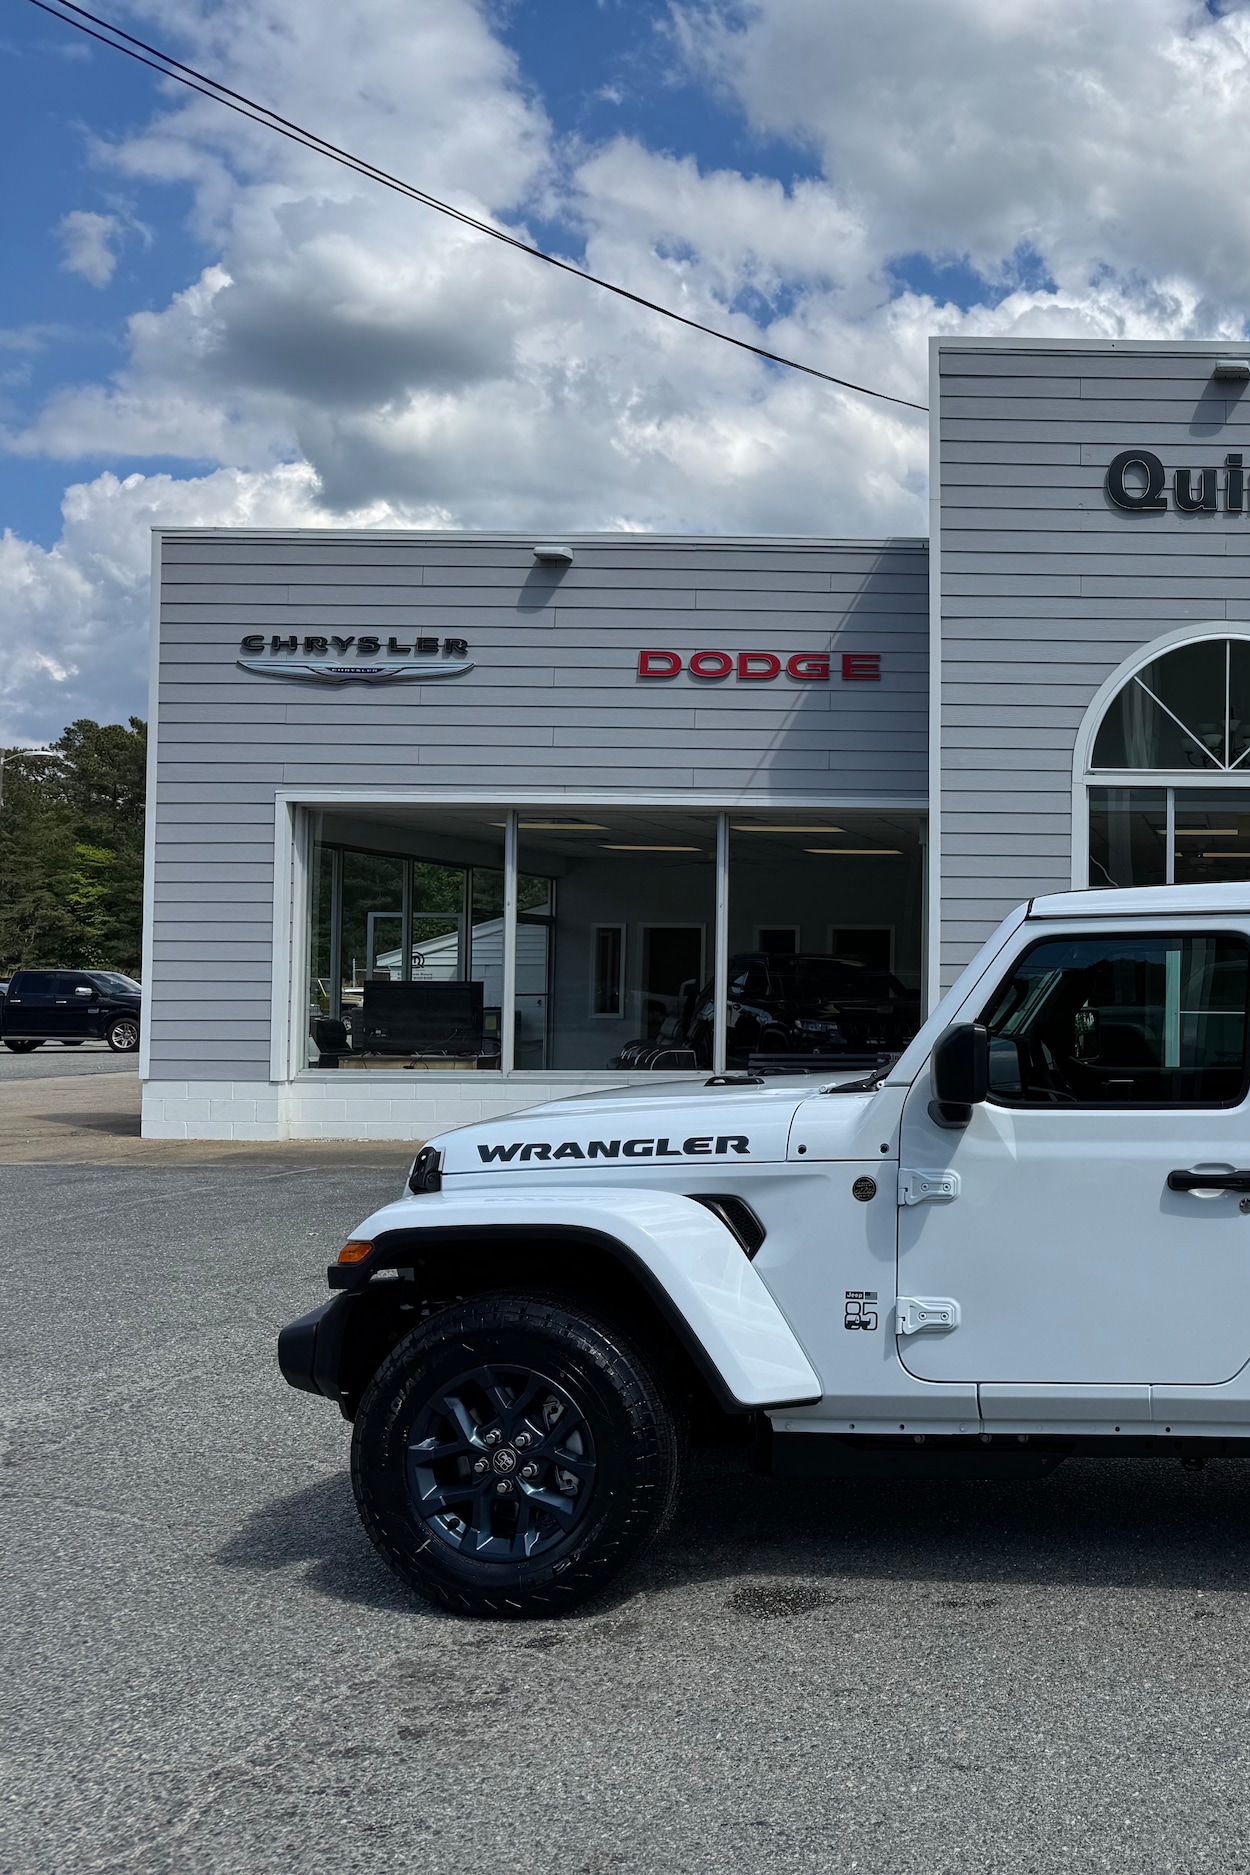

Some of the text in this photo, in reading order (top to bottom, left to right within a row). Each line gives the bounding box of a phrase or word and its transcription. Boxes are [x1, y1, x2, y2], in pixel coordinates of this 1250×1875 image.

[241, 635, 469, 653] CHRYSLER
[638, 650, 882, 682] DODGE
[476, 1135, 751, 1163] WRANGLER
[844, 1301, 878, 1331] 85
